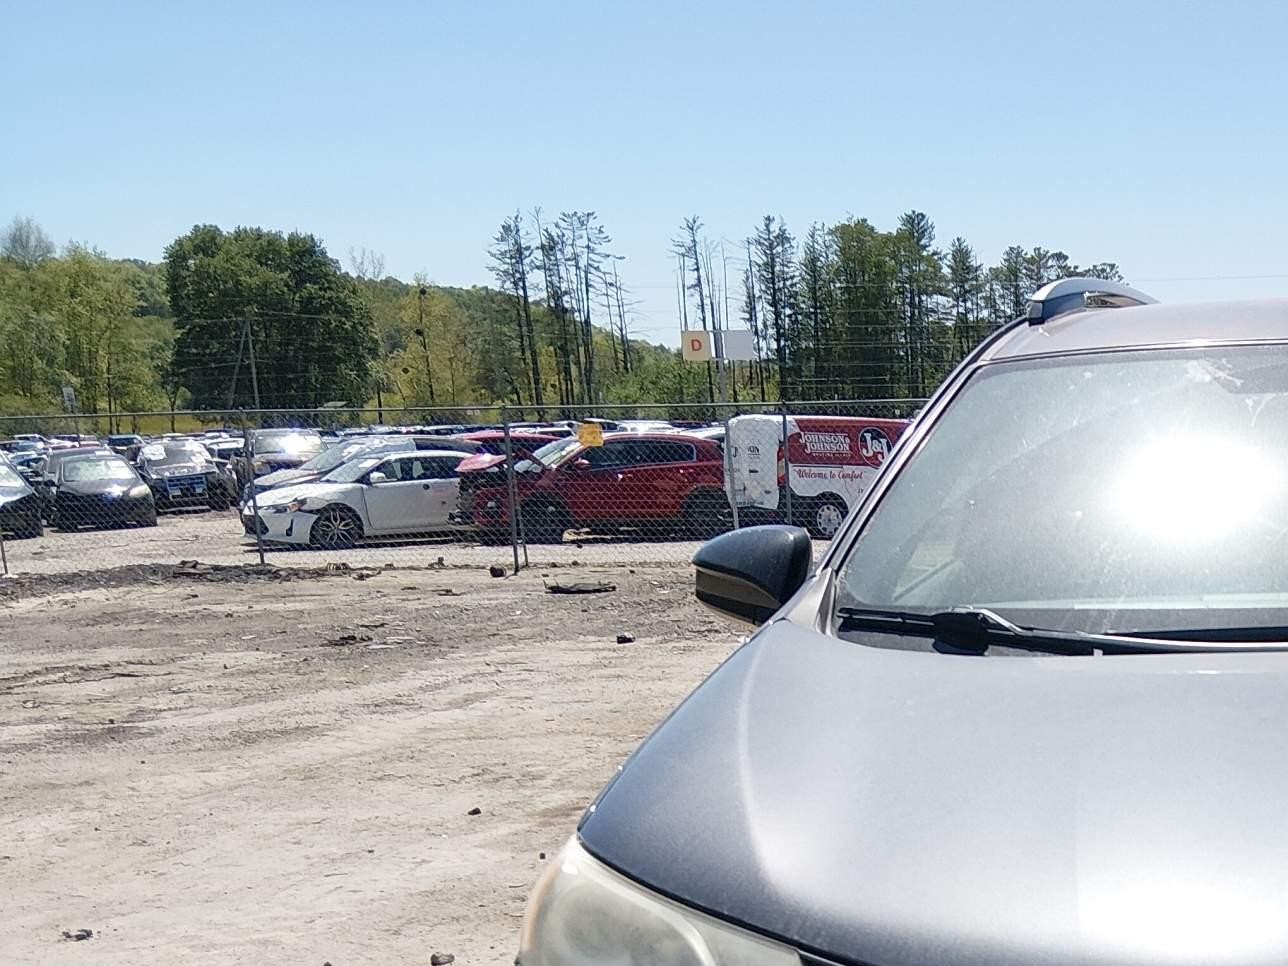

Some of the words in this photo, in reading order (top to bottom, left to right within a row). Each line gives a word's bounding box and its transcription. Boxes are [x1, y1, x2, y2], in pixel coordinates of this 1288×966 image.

[690, 338, 702, 352] D
[804, 442, 851, 454] JOHNSON
[829, 470, 837, 480] to
